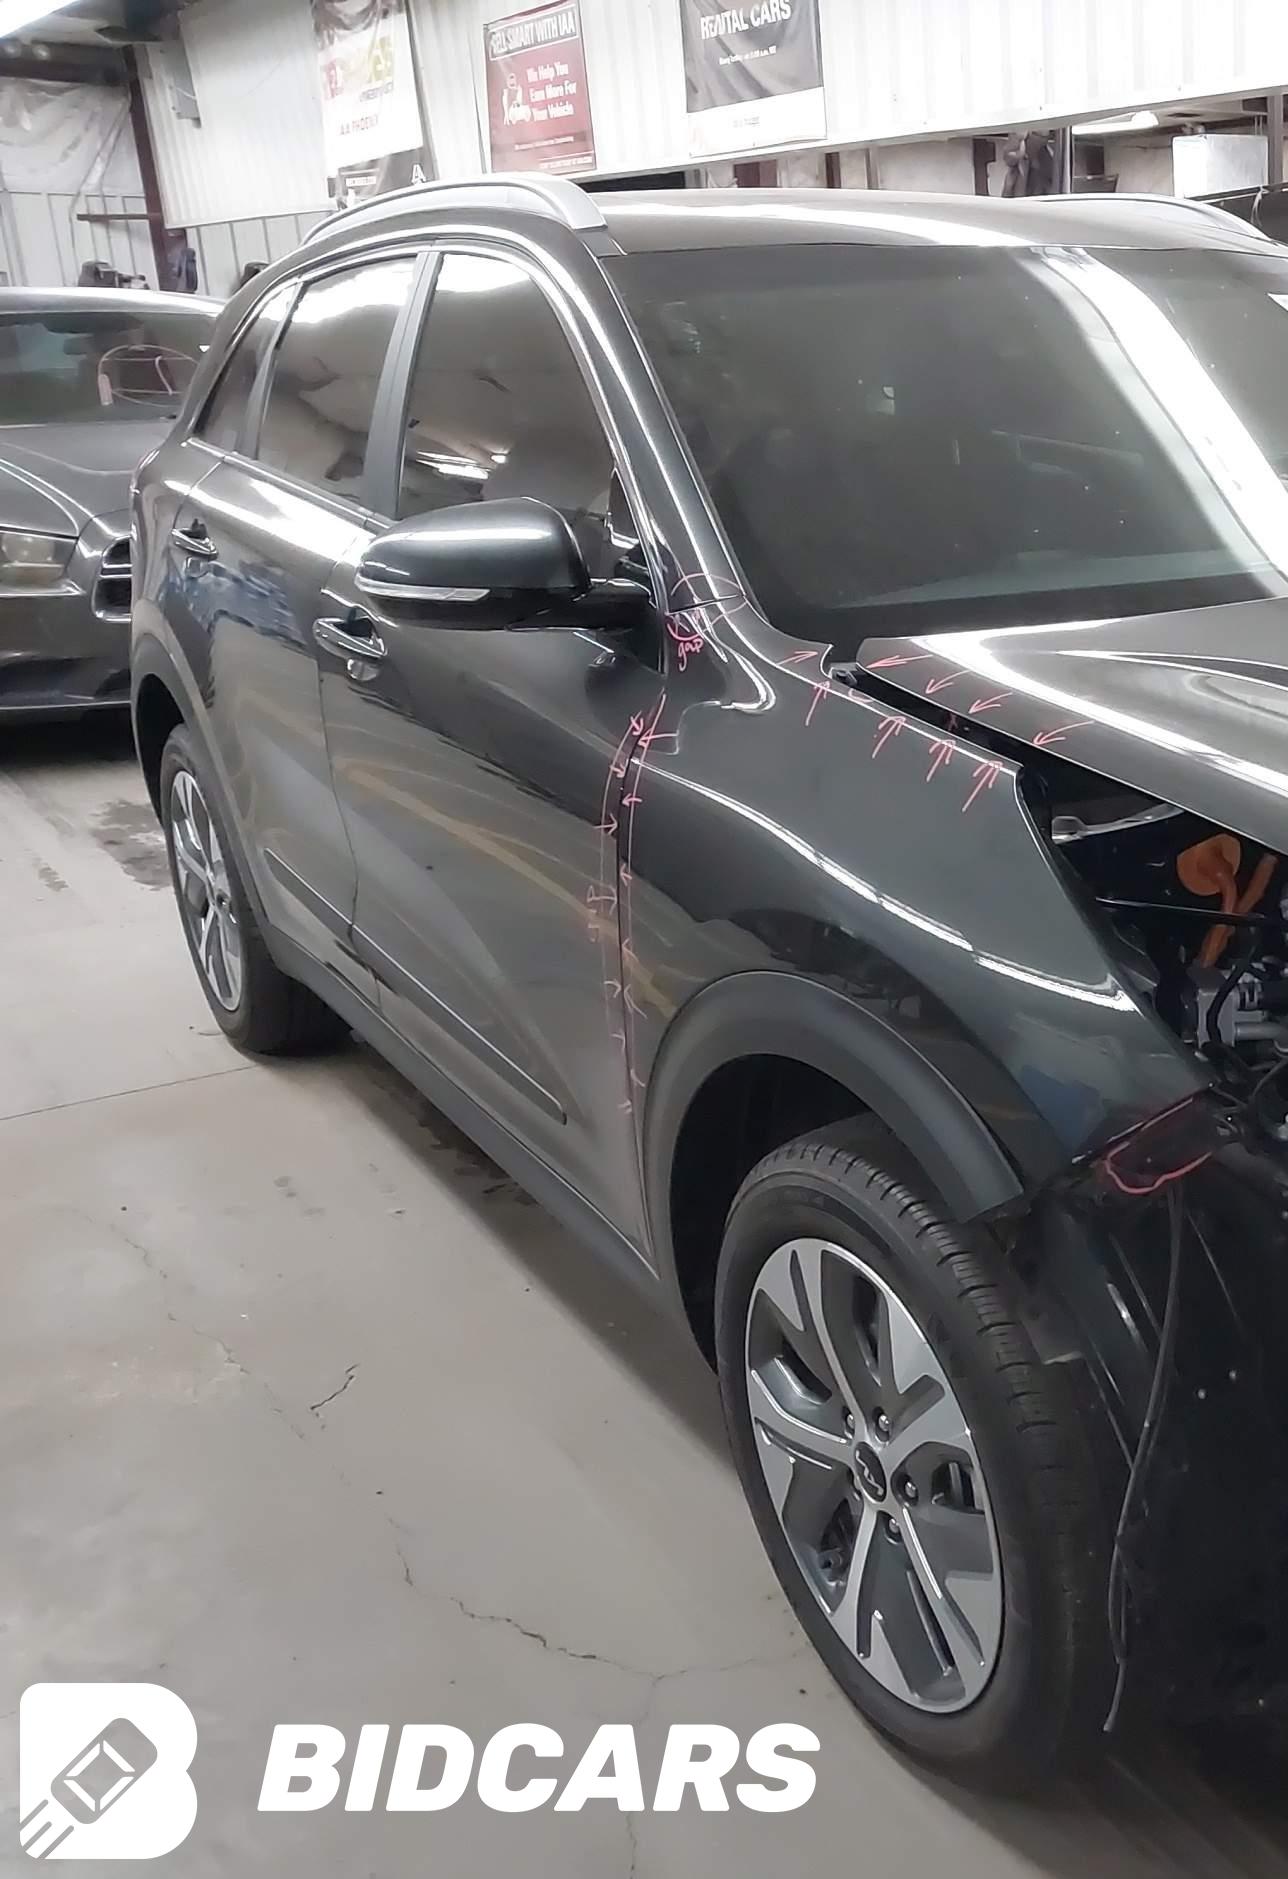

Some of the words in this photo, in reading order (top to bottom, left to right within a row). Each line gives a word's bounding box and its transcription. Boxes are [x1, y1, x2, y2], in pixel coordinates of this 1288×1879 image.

[749, 0, 791, 27] CARS
[507, 22, 535, 50] SMART
[535, 15, 559, 43] WITH
[558, 11, 576, 36] IAA
